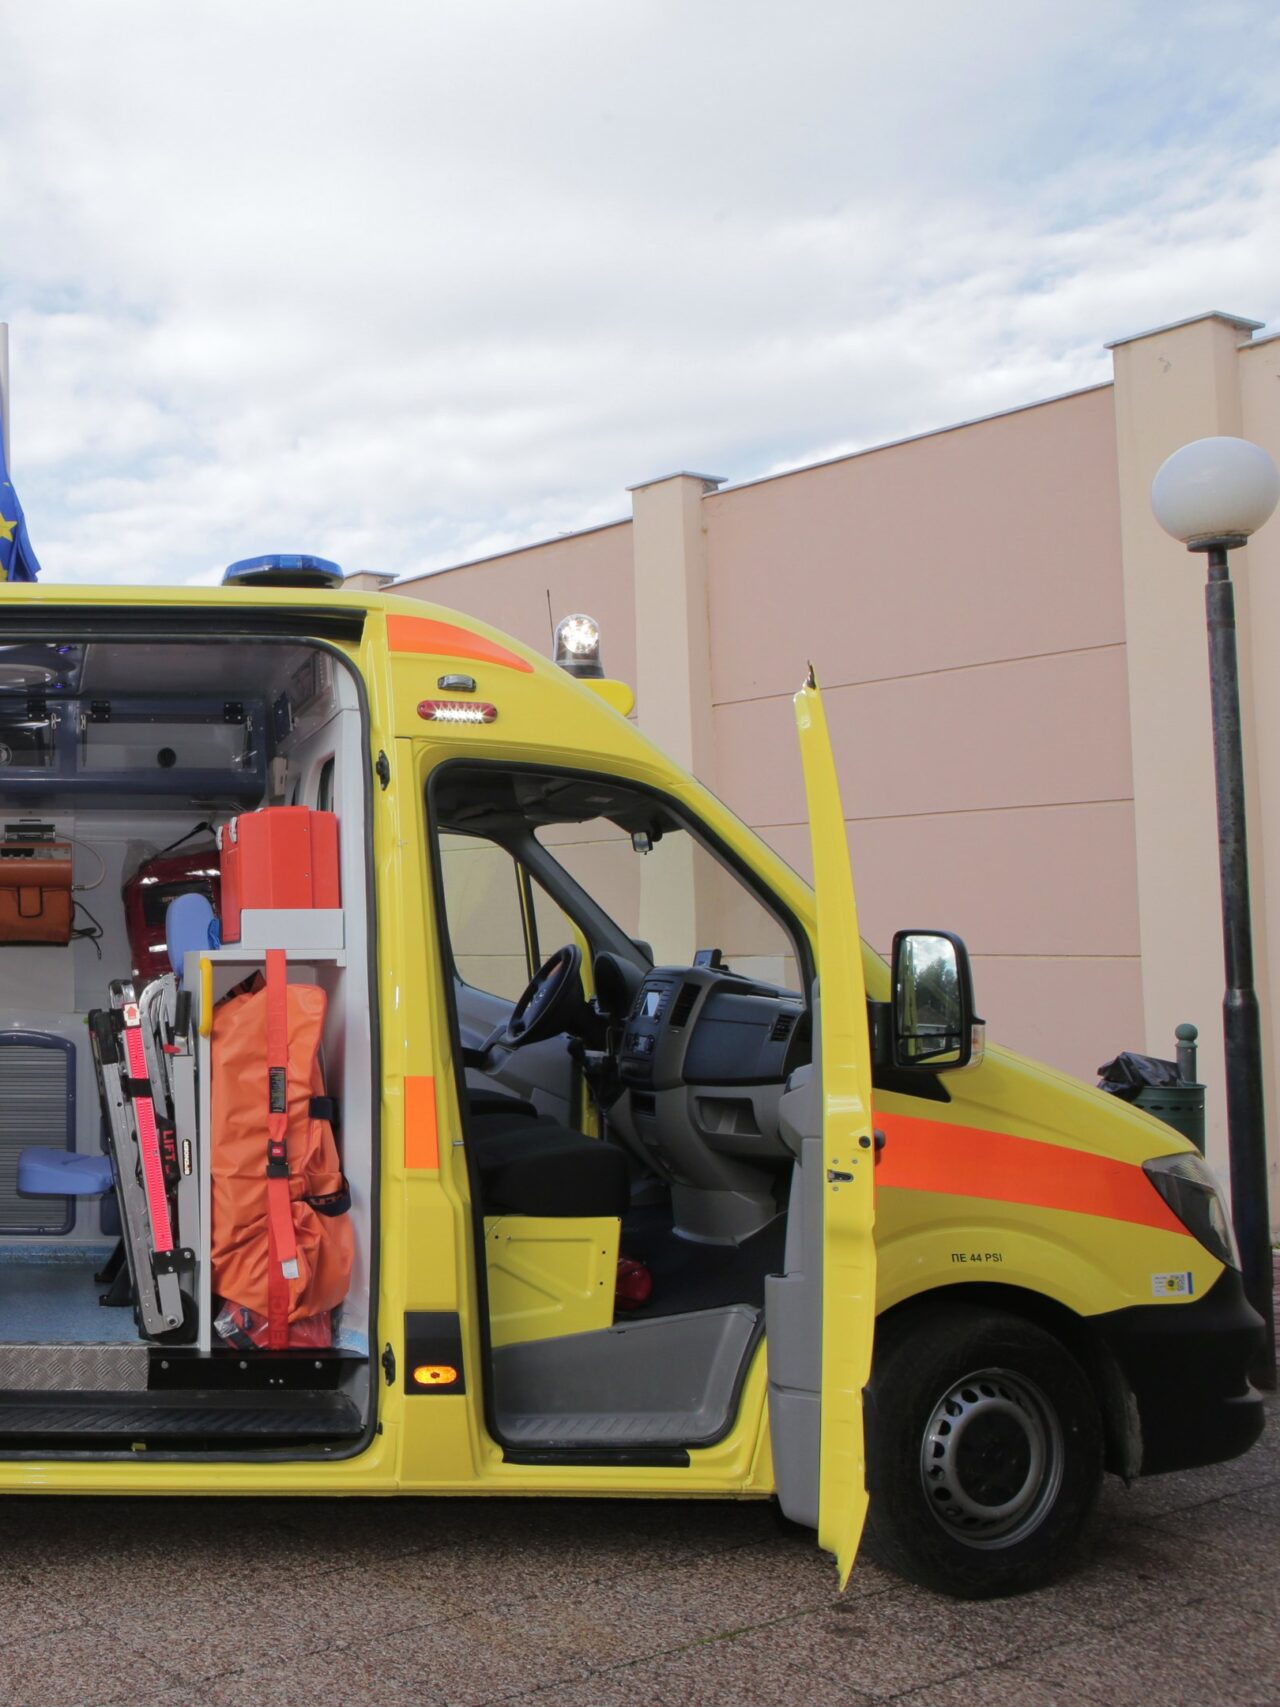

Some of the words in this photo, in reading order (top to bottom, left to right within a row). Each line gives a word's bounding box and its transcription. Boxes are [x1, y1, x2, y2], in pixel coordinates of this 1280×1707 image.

[163, 1130, 176, 1161] LIFT
[970, 1253, 982, 1262] 44
[985, 1253, 1003, 1263] PSI
